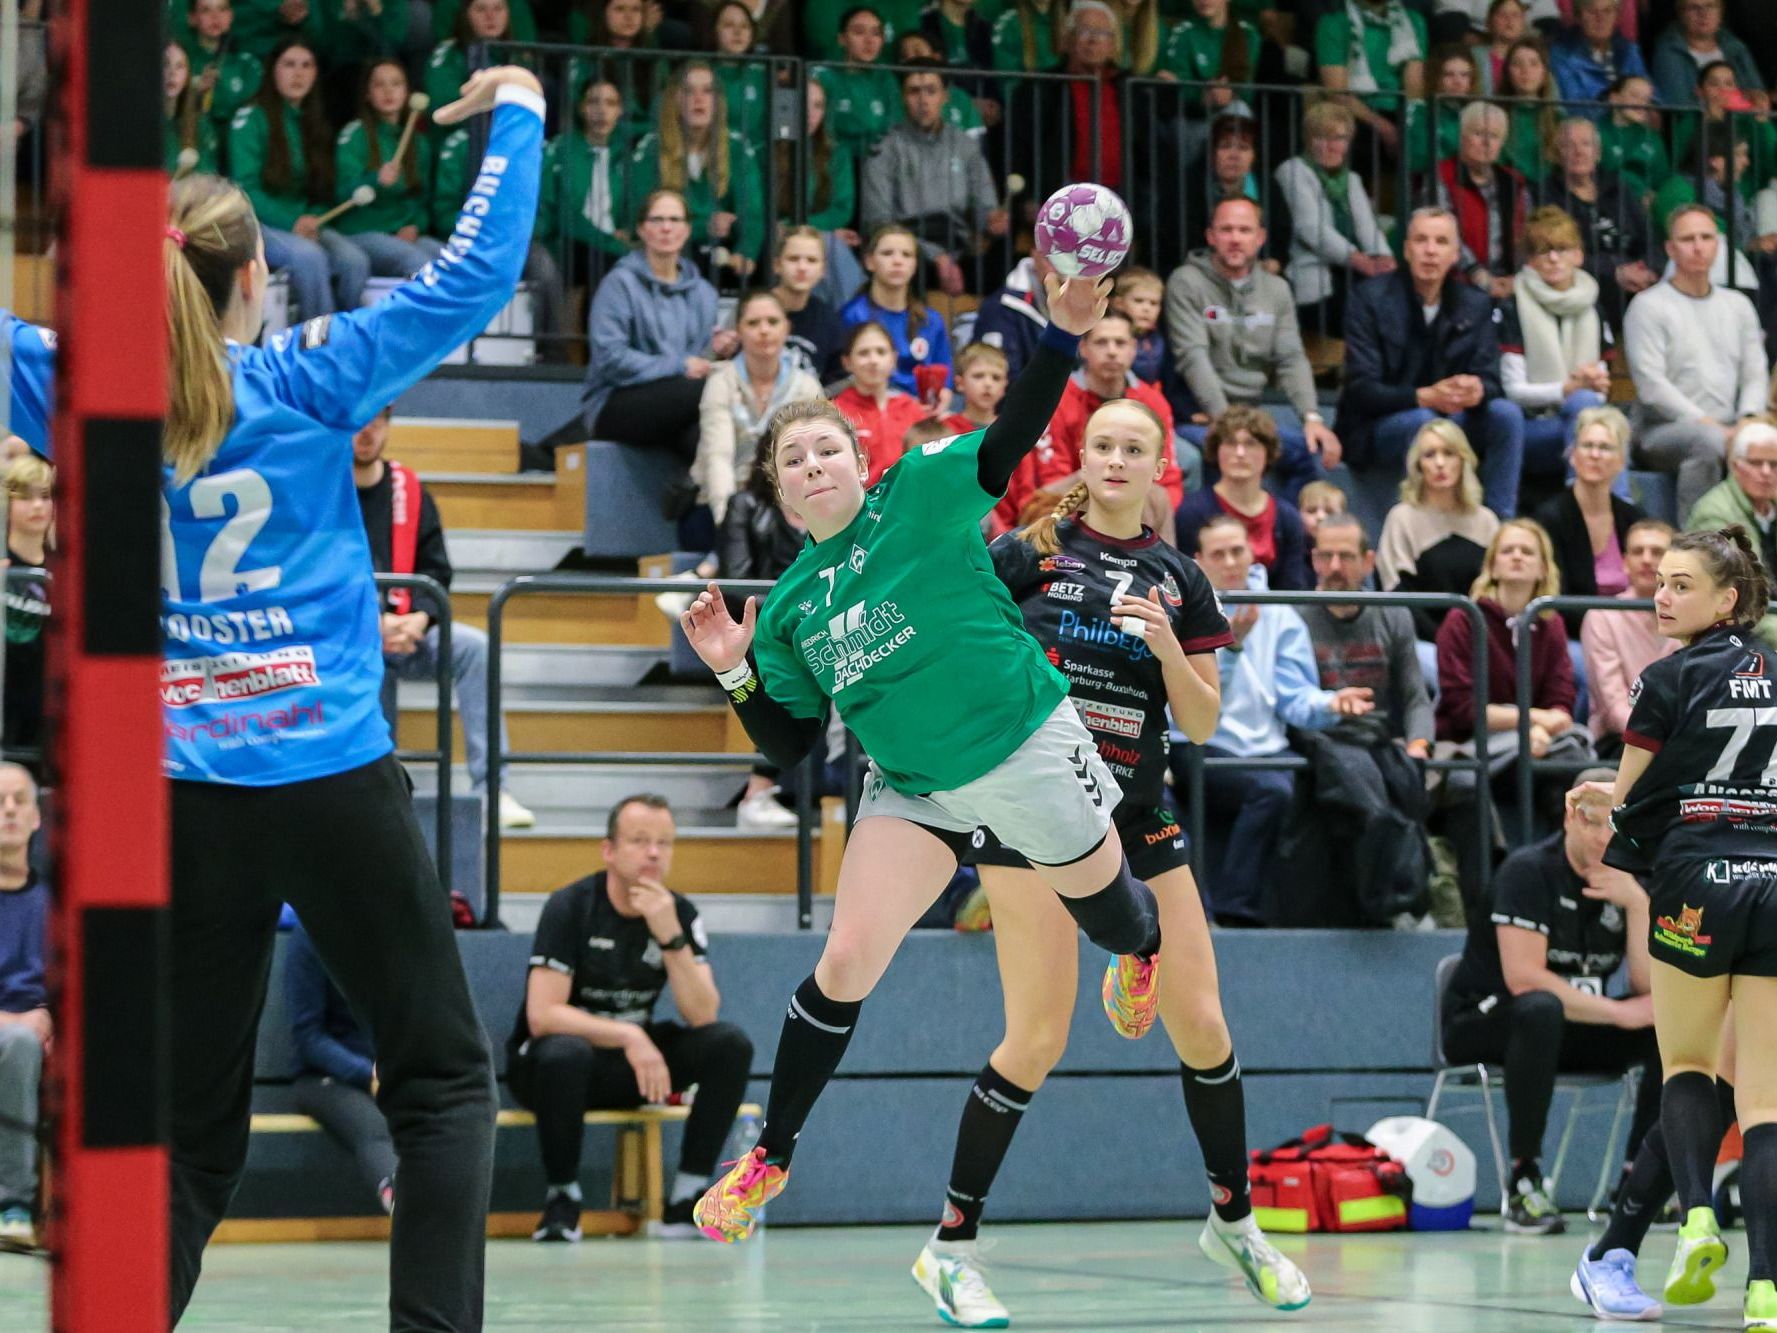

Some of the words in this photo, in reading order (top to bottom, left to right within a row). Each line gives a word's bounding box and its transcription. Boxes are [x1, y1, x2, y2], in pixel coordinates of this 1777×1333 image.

[1047, 591, 1083, 603] HOLDING
[1049, 581, 1086, 597] BETZ
[1104, 569, 1134, 606] 7
[160, 606, 294, 645] OOSTER
[834, 625, 917, 685] DACHDECKER
[1063, 659, 1116, 680] Sparkasse
[1728, 678, 1773, 699] FMT
